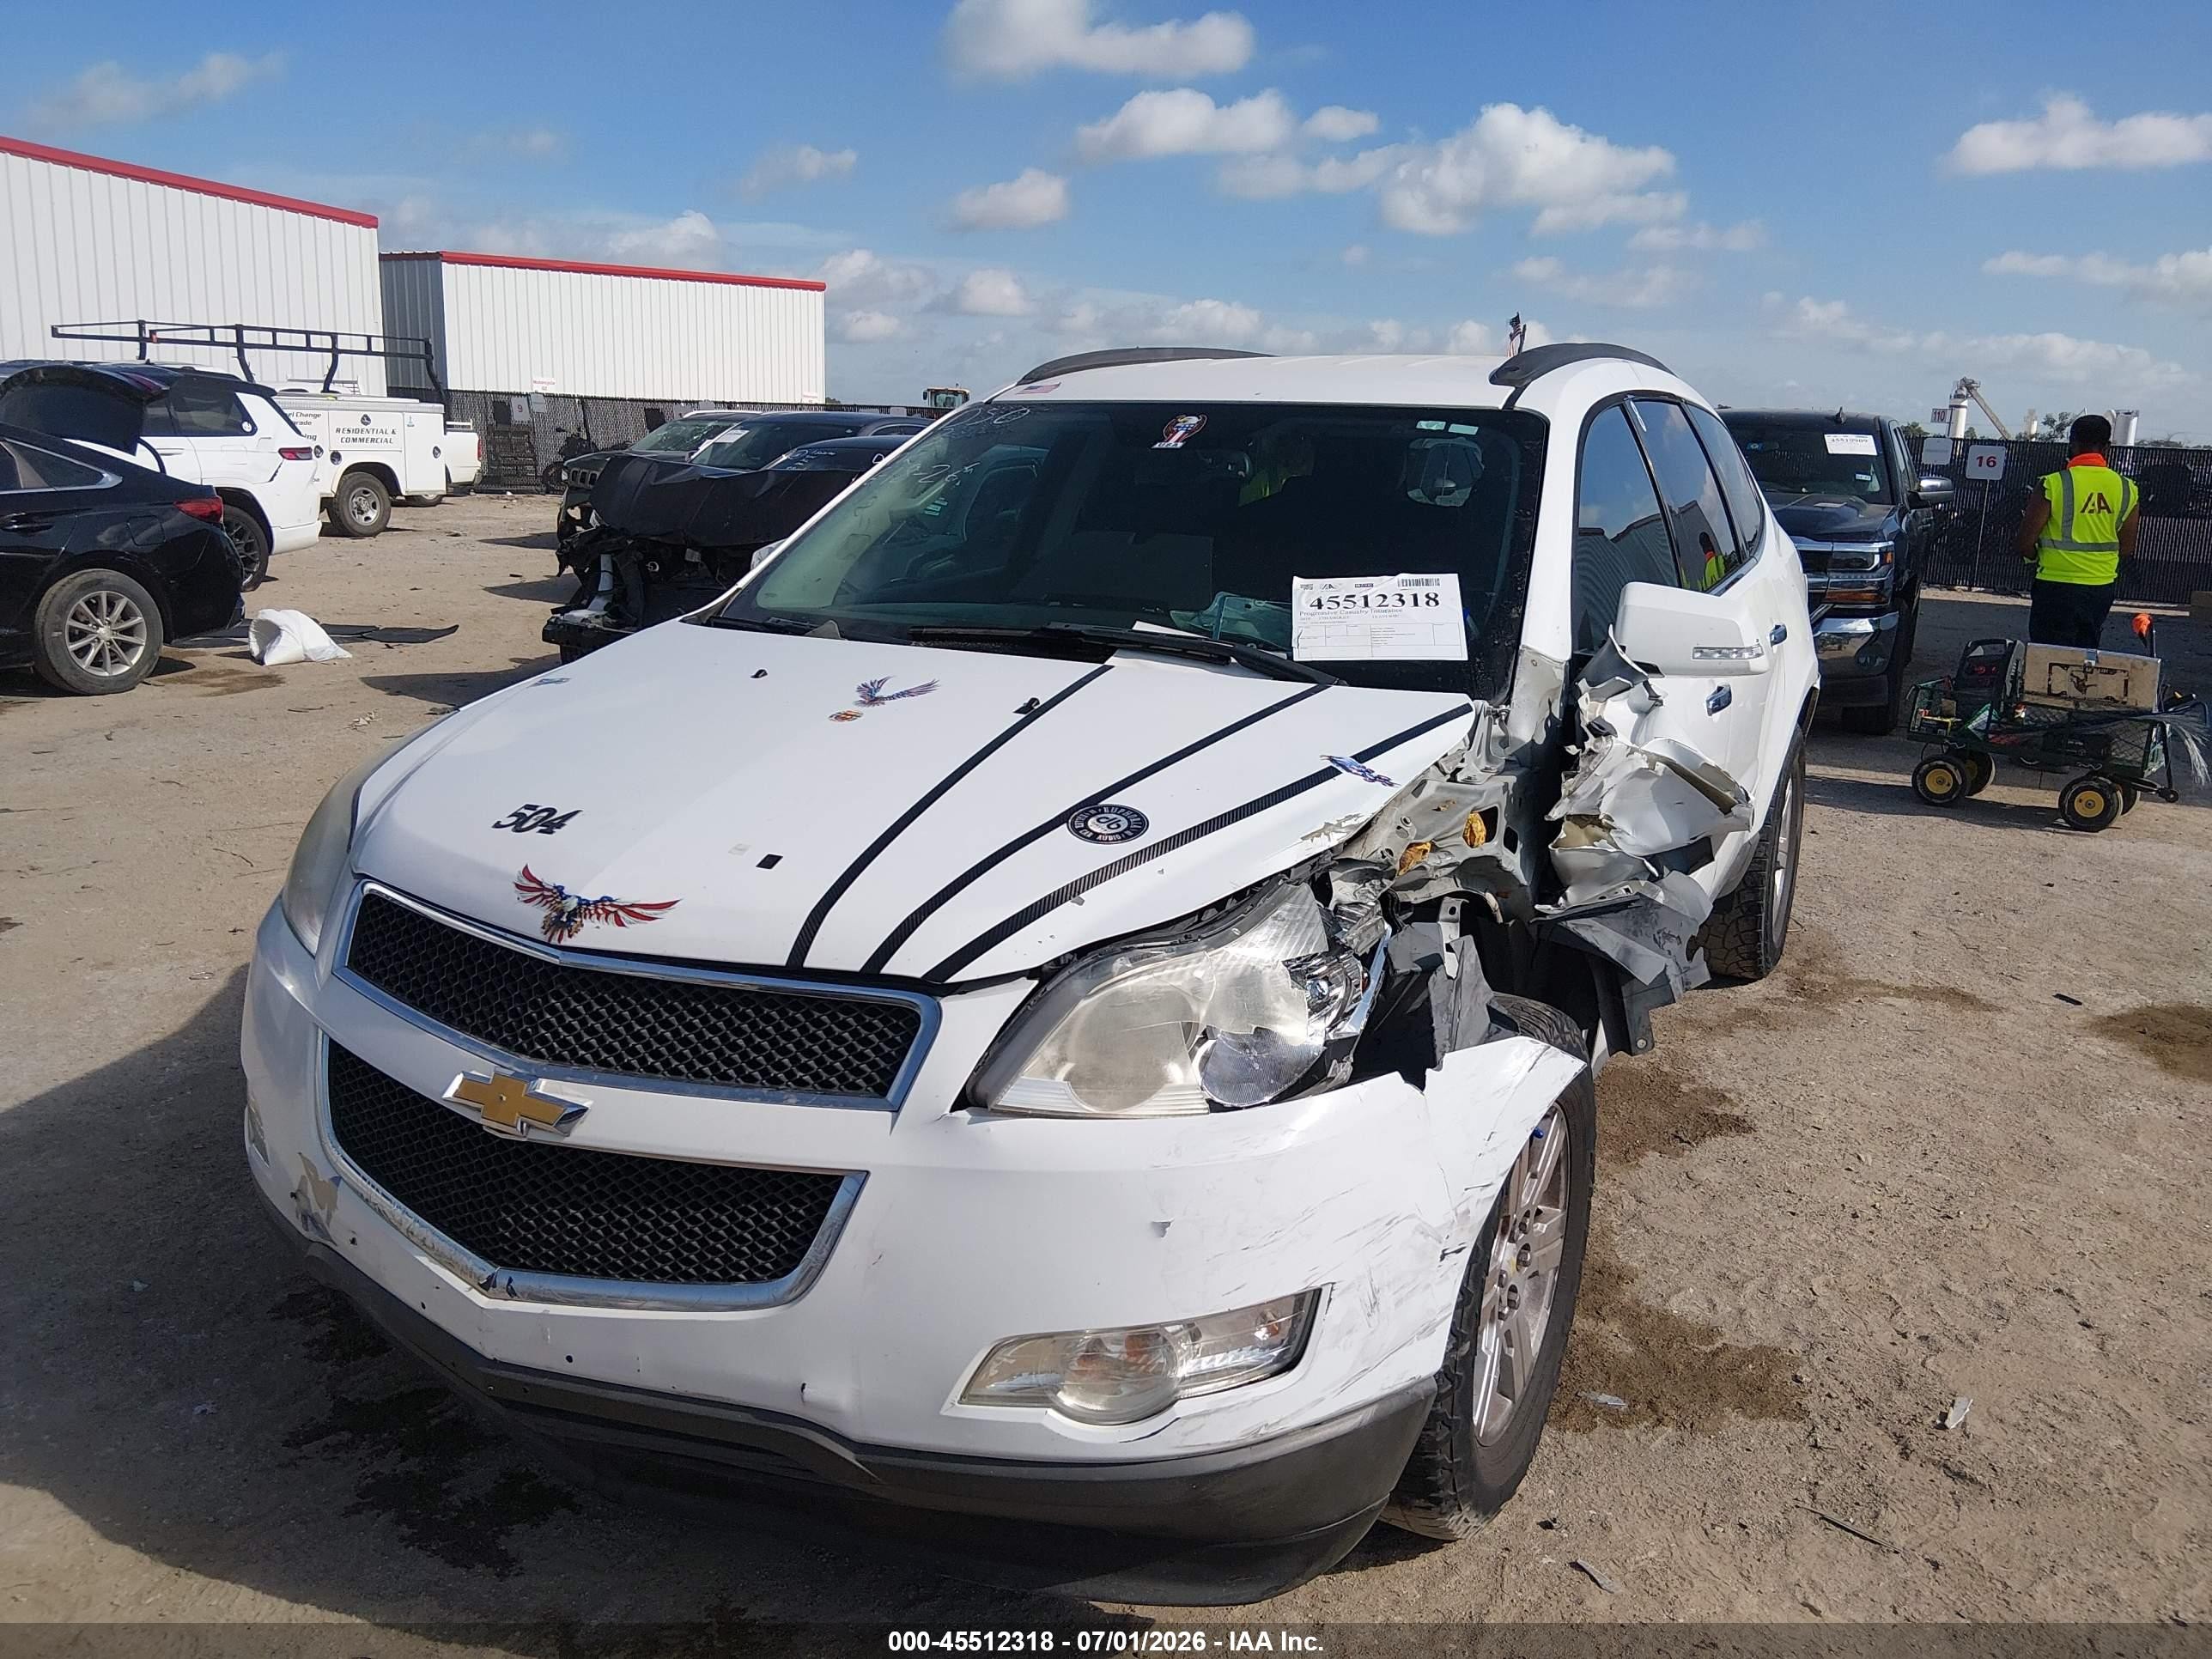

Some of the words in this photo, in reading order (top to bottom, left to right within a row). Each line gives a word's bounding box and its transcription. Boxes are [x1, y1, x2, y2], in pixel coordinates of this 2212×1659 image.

[1933, 410, 1946, 421] 110
[1976, 456, 1997, 468] 16
[1310, 592, 1440, 610] 45512318
[490, 803, 583, 835] 504
